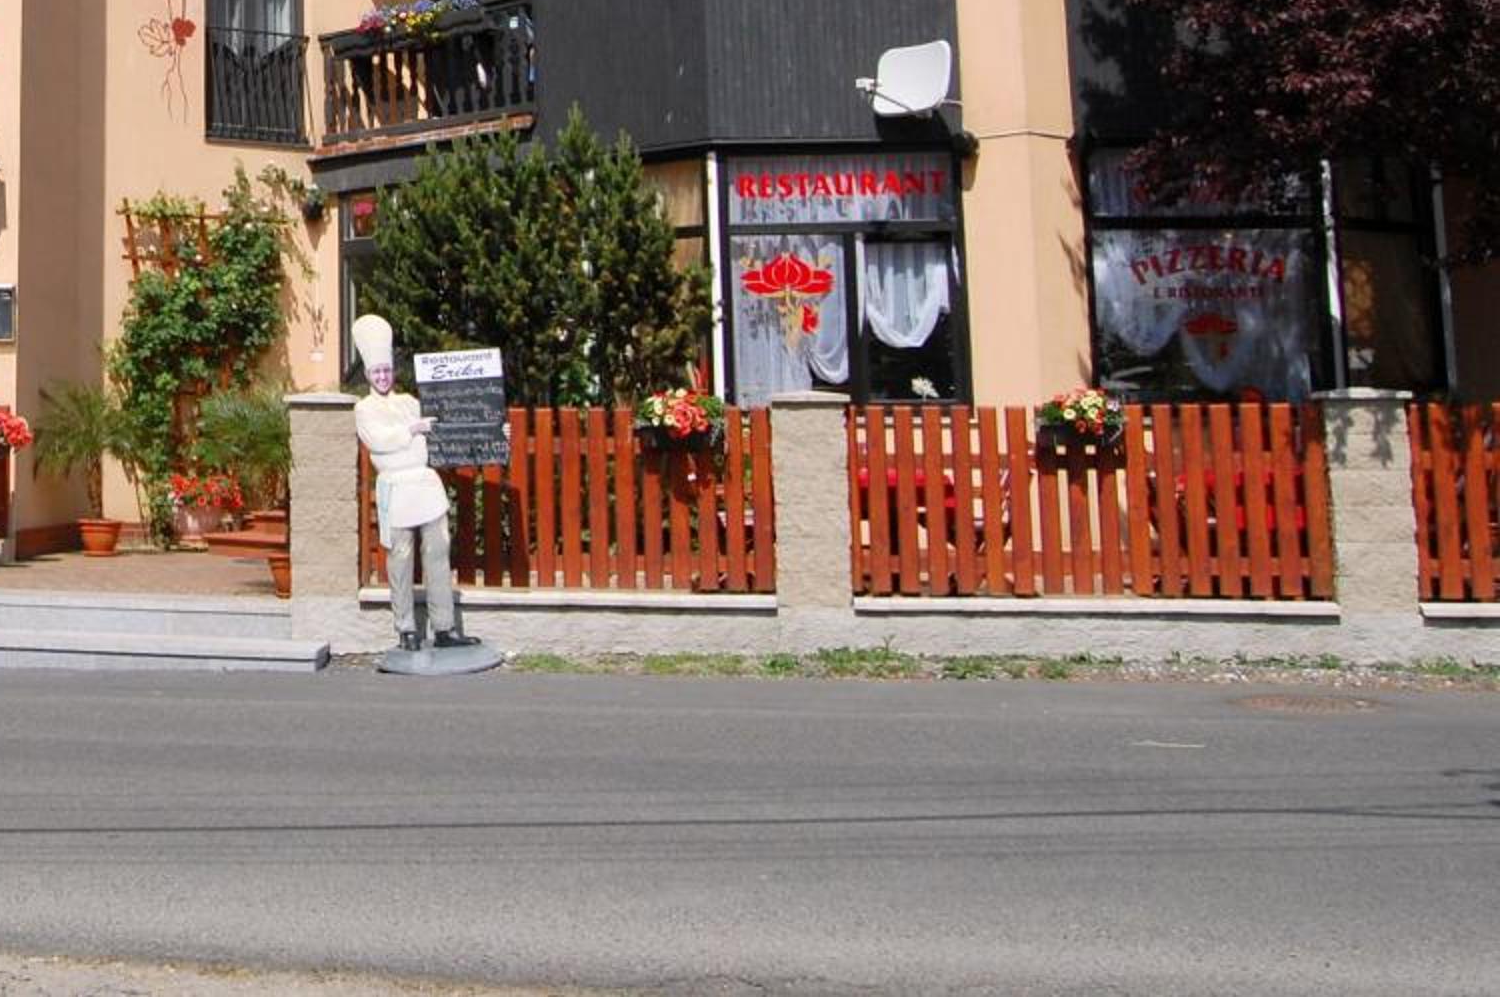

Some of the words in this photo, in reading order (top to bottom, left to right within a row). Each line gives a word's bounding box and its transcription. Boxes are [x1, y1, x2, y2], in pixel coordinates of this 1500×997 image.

[736, 171, 945, 198] RESTAURANT
[1130, 245, 1286, 285] PIZZERIA
[431, 363, 485, 380] Erika
